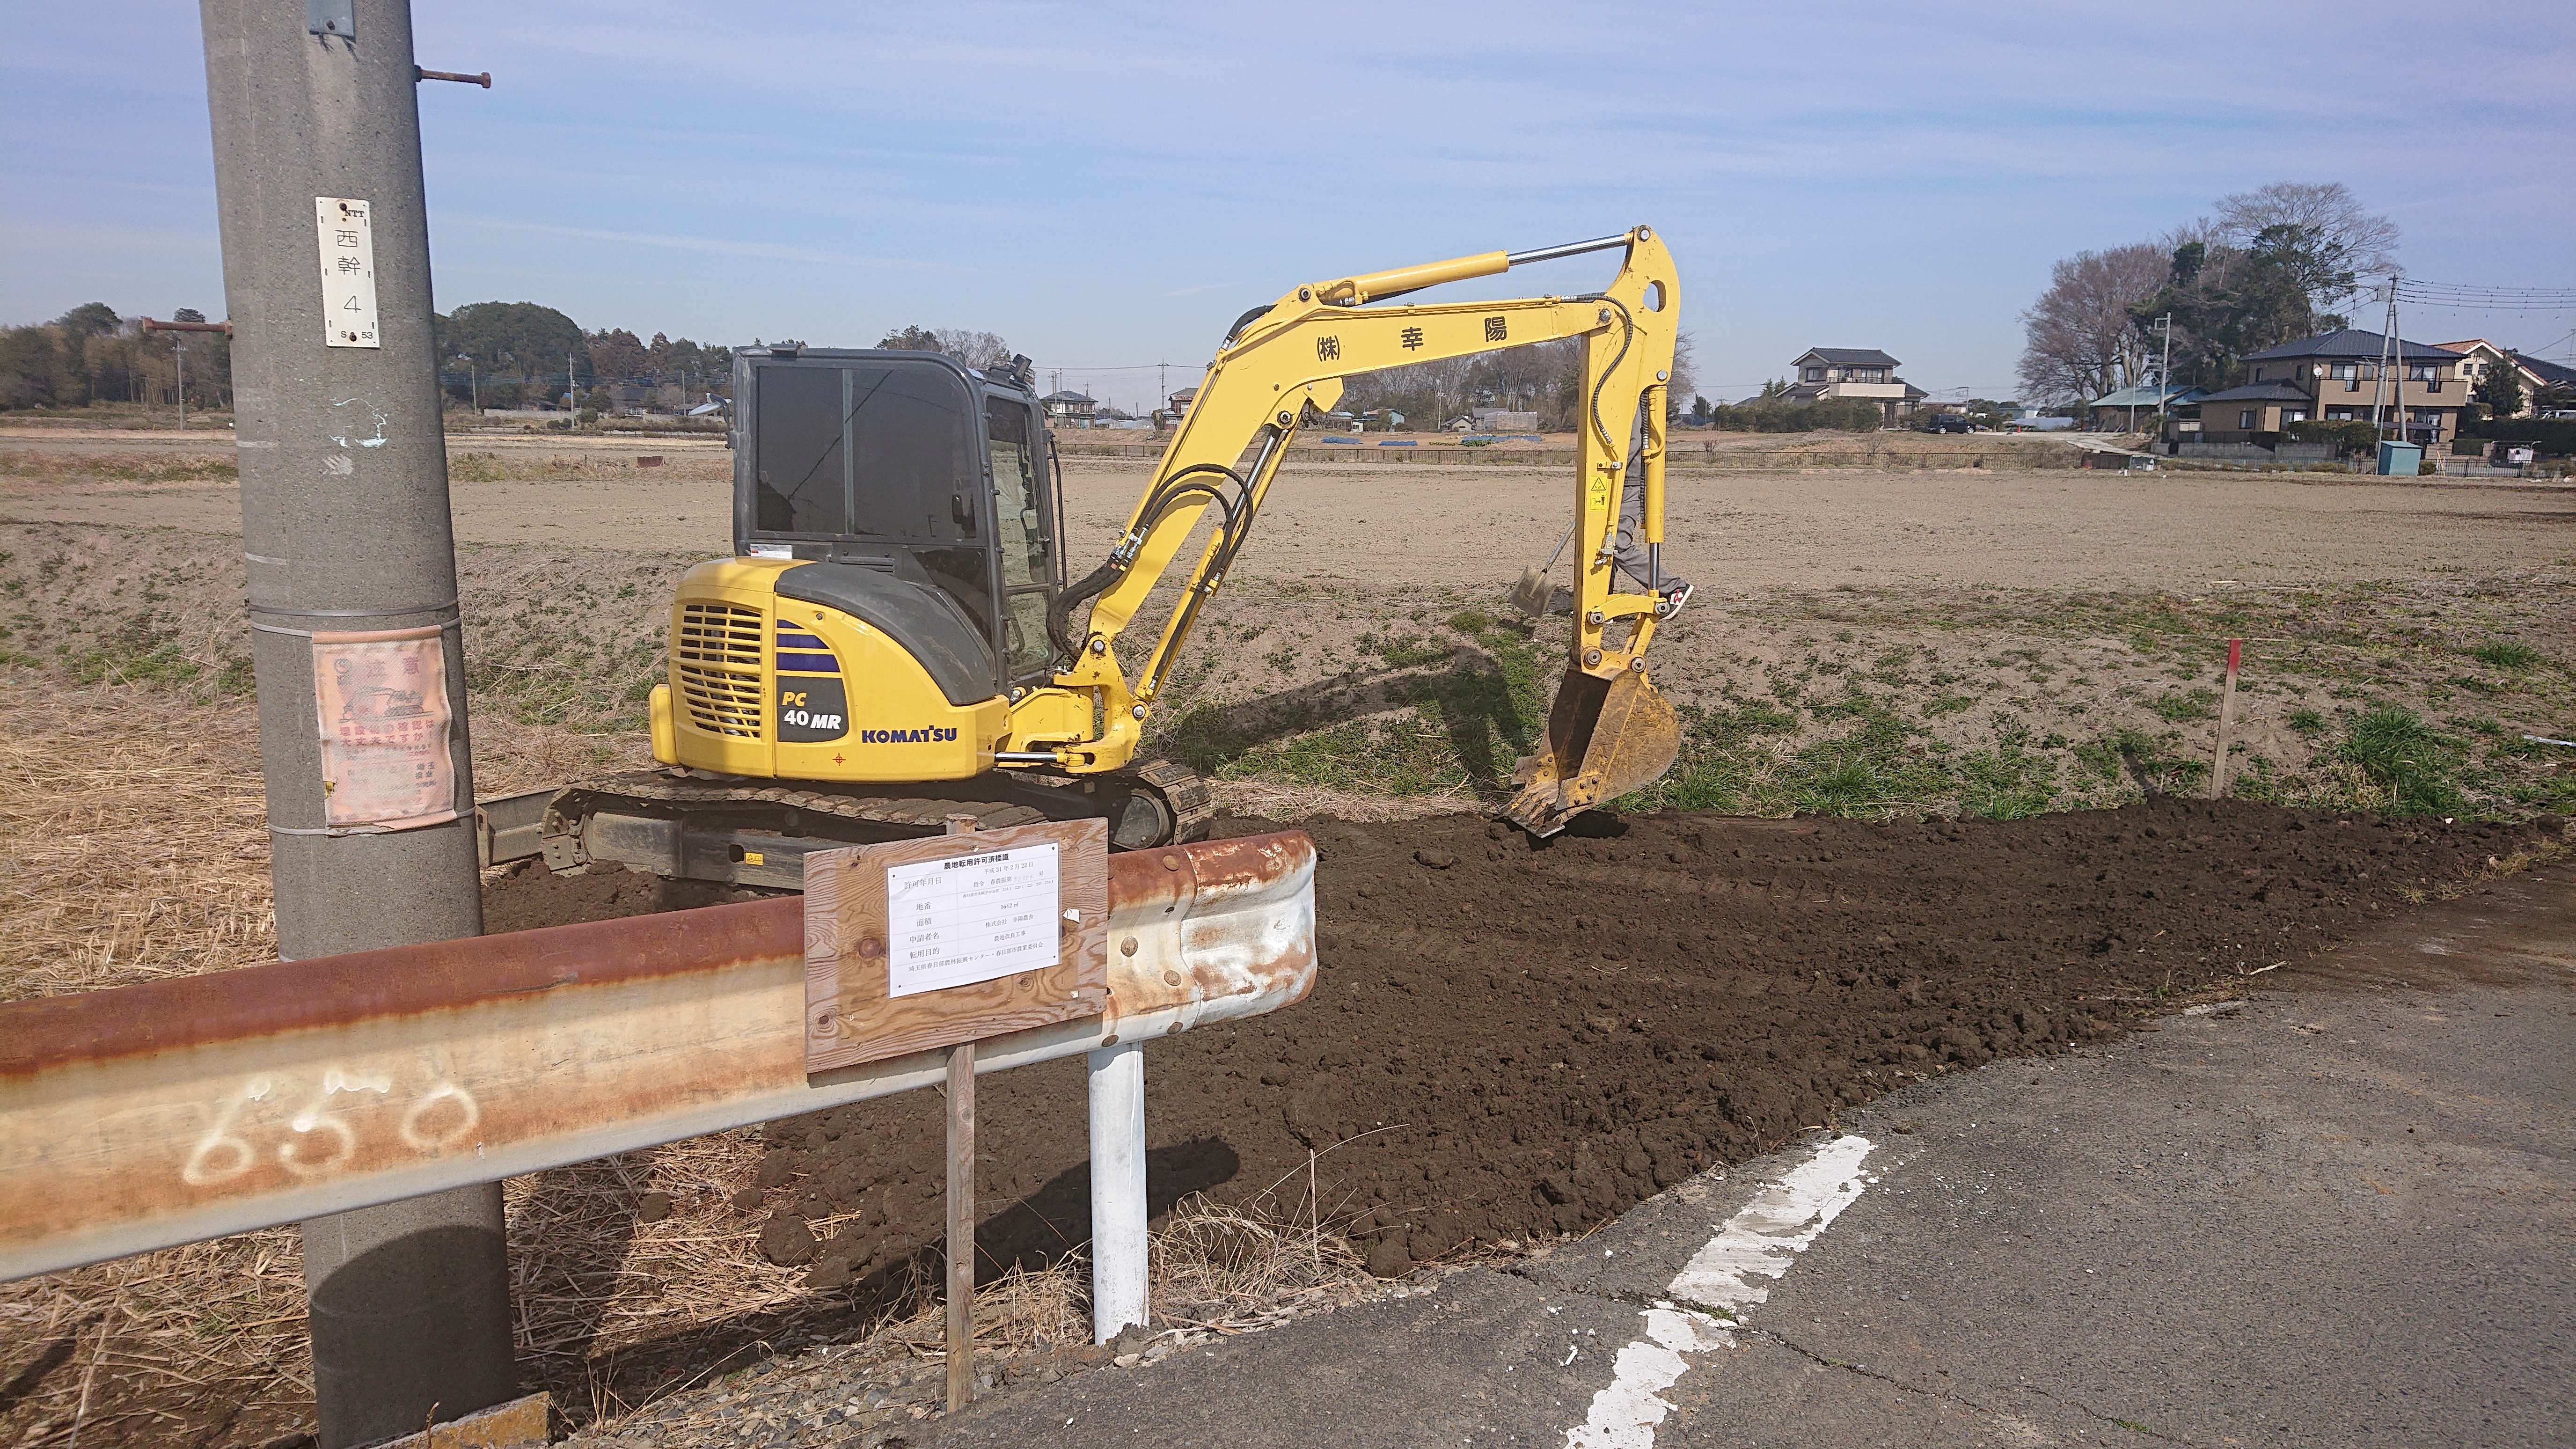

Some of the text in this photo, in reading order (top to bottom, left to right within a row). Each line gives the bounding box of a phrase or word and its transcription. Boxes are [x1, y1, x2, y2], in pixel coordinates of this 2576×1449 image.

[344, 209, 365, 218] NTT
[344, 295, 361, 313] 4
[782, 691, 807, 707] PC
[784, 710, 842, 730] 40 MR
[862, 725, 957, 743] KOMATSU
[944, 853, 1010, 870] 農地転用許可済標識
[904, 877, 942, 889] 許可年月日
[916, 901, 932, 911] 地番
[916, 917, 932, 927] 面積
[985, 919, 1008, 928] 株式会社
[909, 932, 940, 943] 申請者名
[994, 930, 1026, 942] 農地改良工事
[909, 947, 940, 959] 転用目的
